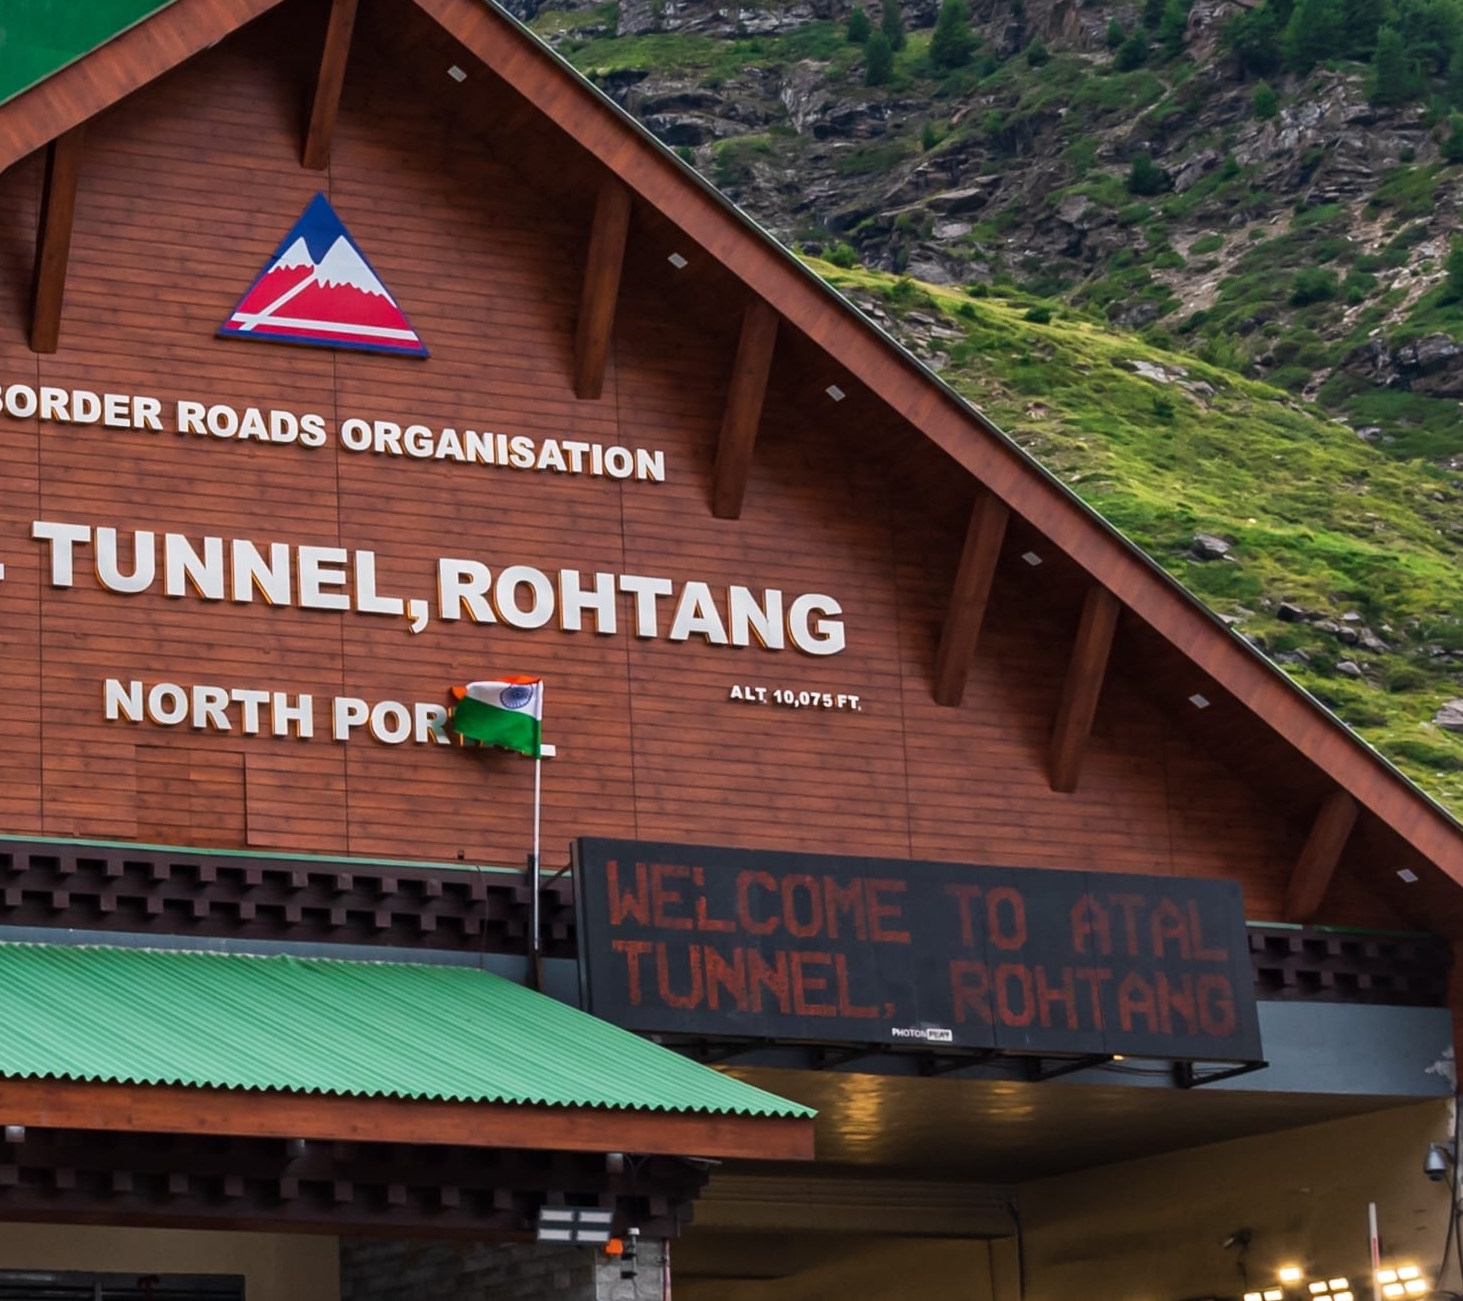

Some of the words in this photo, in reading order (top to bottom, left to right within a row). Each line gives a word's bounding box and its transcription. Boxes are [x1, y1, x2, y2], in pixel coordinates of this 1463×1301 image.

[177, 400, 327, 448] ROADS
[340, 417, 665, 482] ORGANISATION
[103, 679, 314, 739] NORTH
[773, 689, 833, 708] 10,075
[606, 860, 912, 944] WELCOME
[944, 883, 1028, 950] TO
[1071, 894, 1228, 961] ATAL
[611, 939, 896, 1019] TUNNEL,
[949, 960, 1236, 1036] ROHTANG
